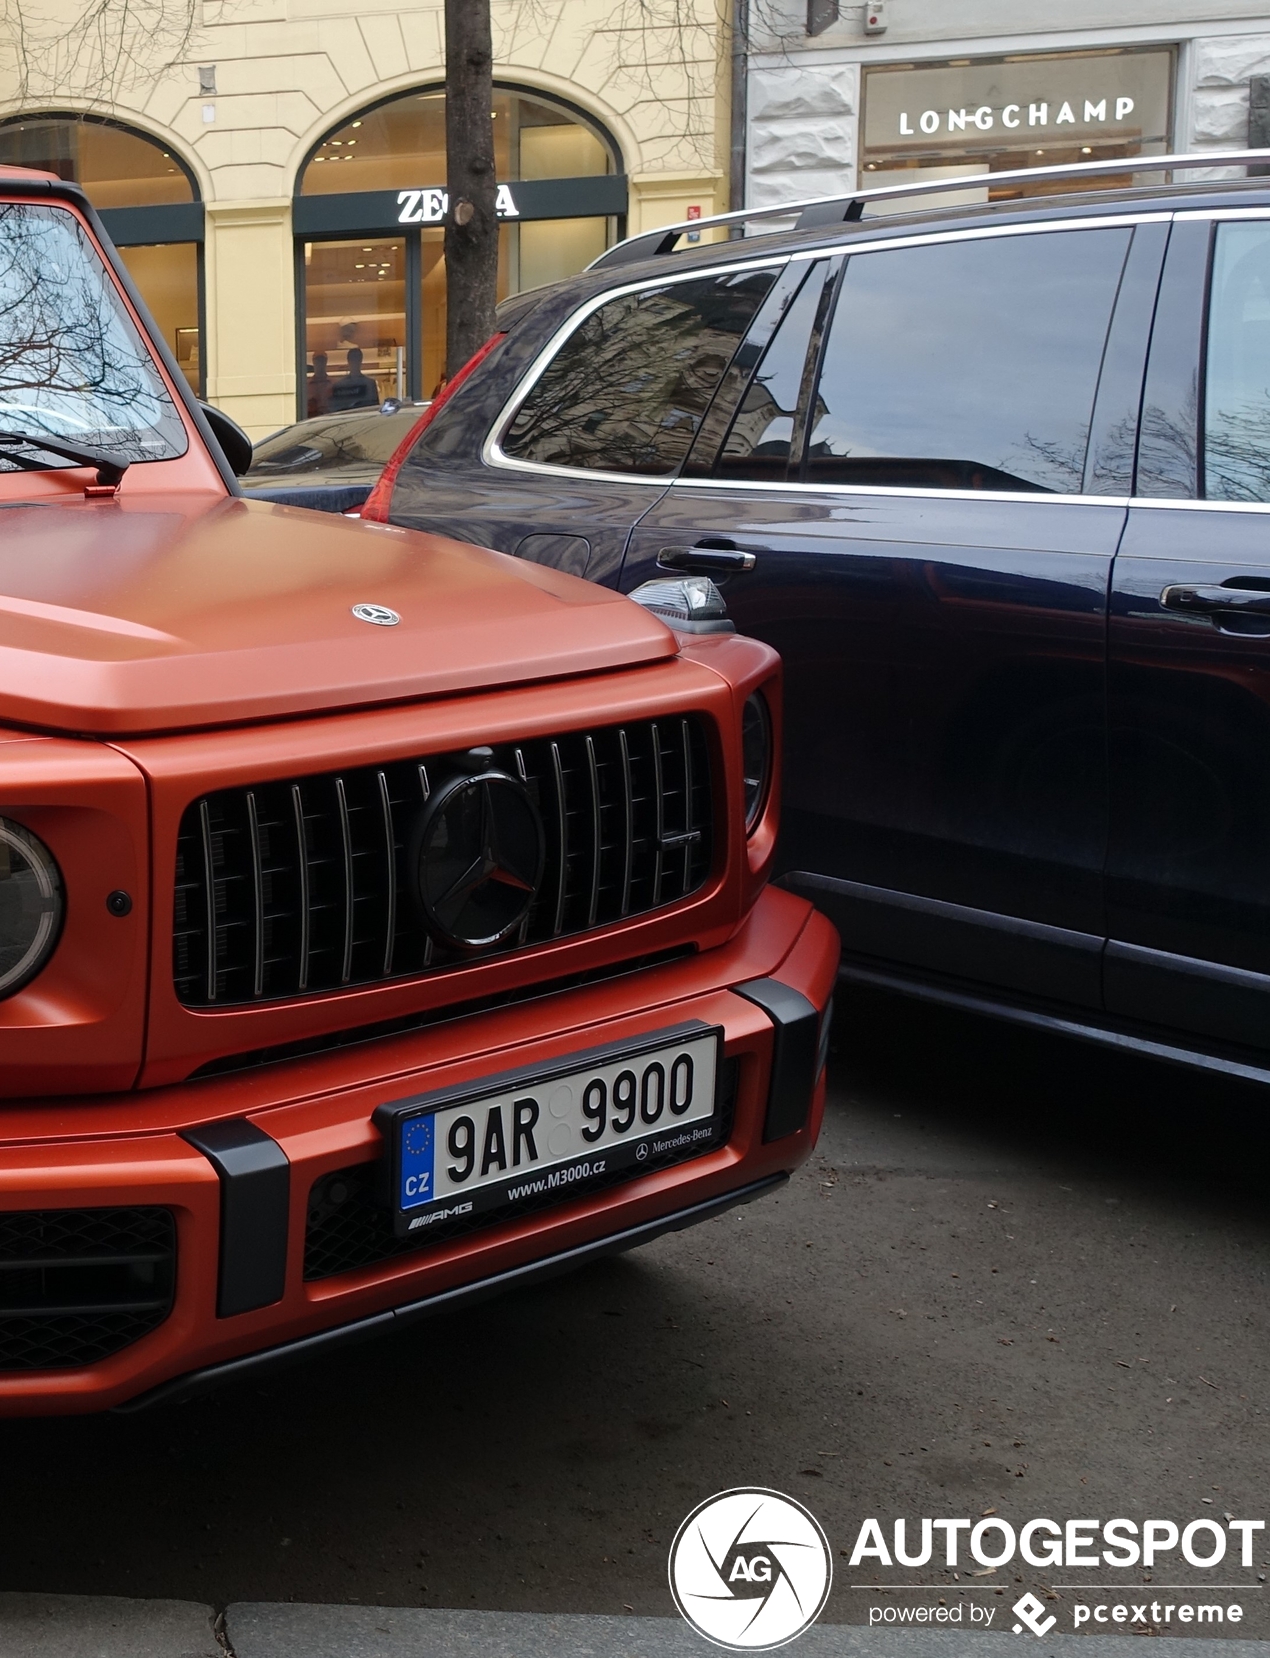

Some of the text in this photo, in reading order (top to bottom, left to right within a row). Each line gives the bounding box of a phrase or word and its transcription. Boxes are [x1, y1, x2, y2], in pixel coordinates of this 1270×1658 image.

[899, 97, 1134, 135] LONGCHAMP
[397, 185, 519, 223] ZEA
[448, 1053, 694, 1182] 9AR 9900
[652, 1127, 712, 1153] Mercedes-Benz
[406, 1172, 429, 1196] CZ
[507, 1160, 606, 1200] www.M3000.cz
